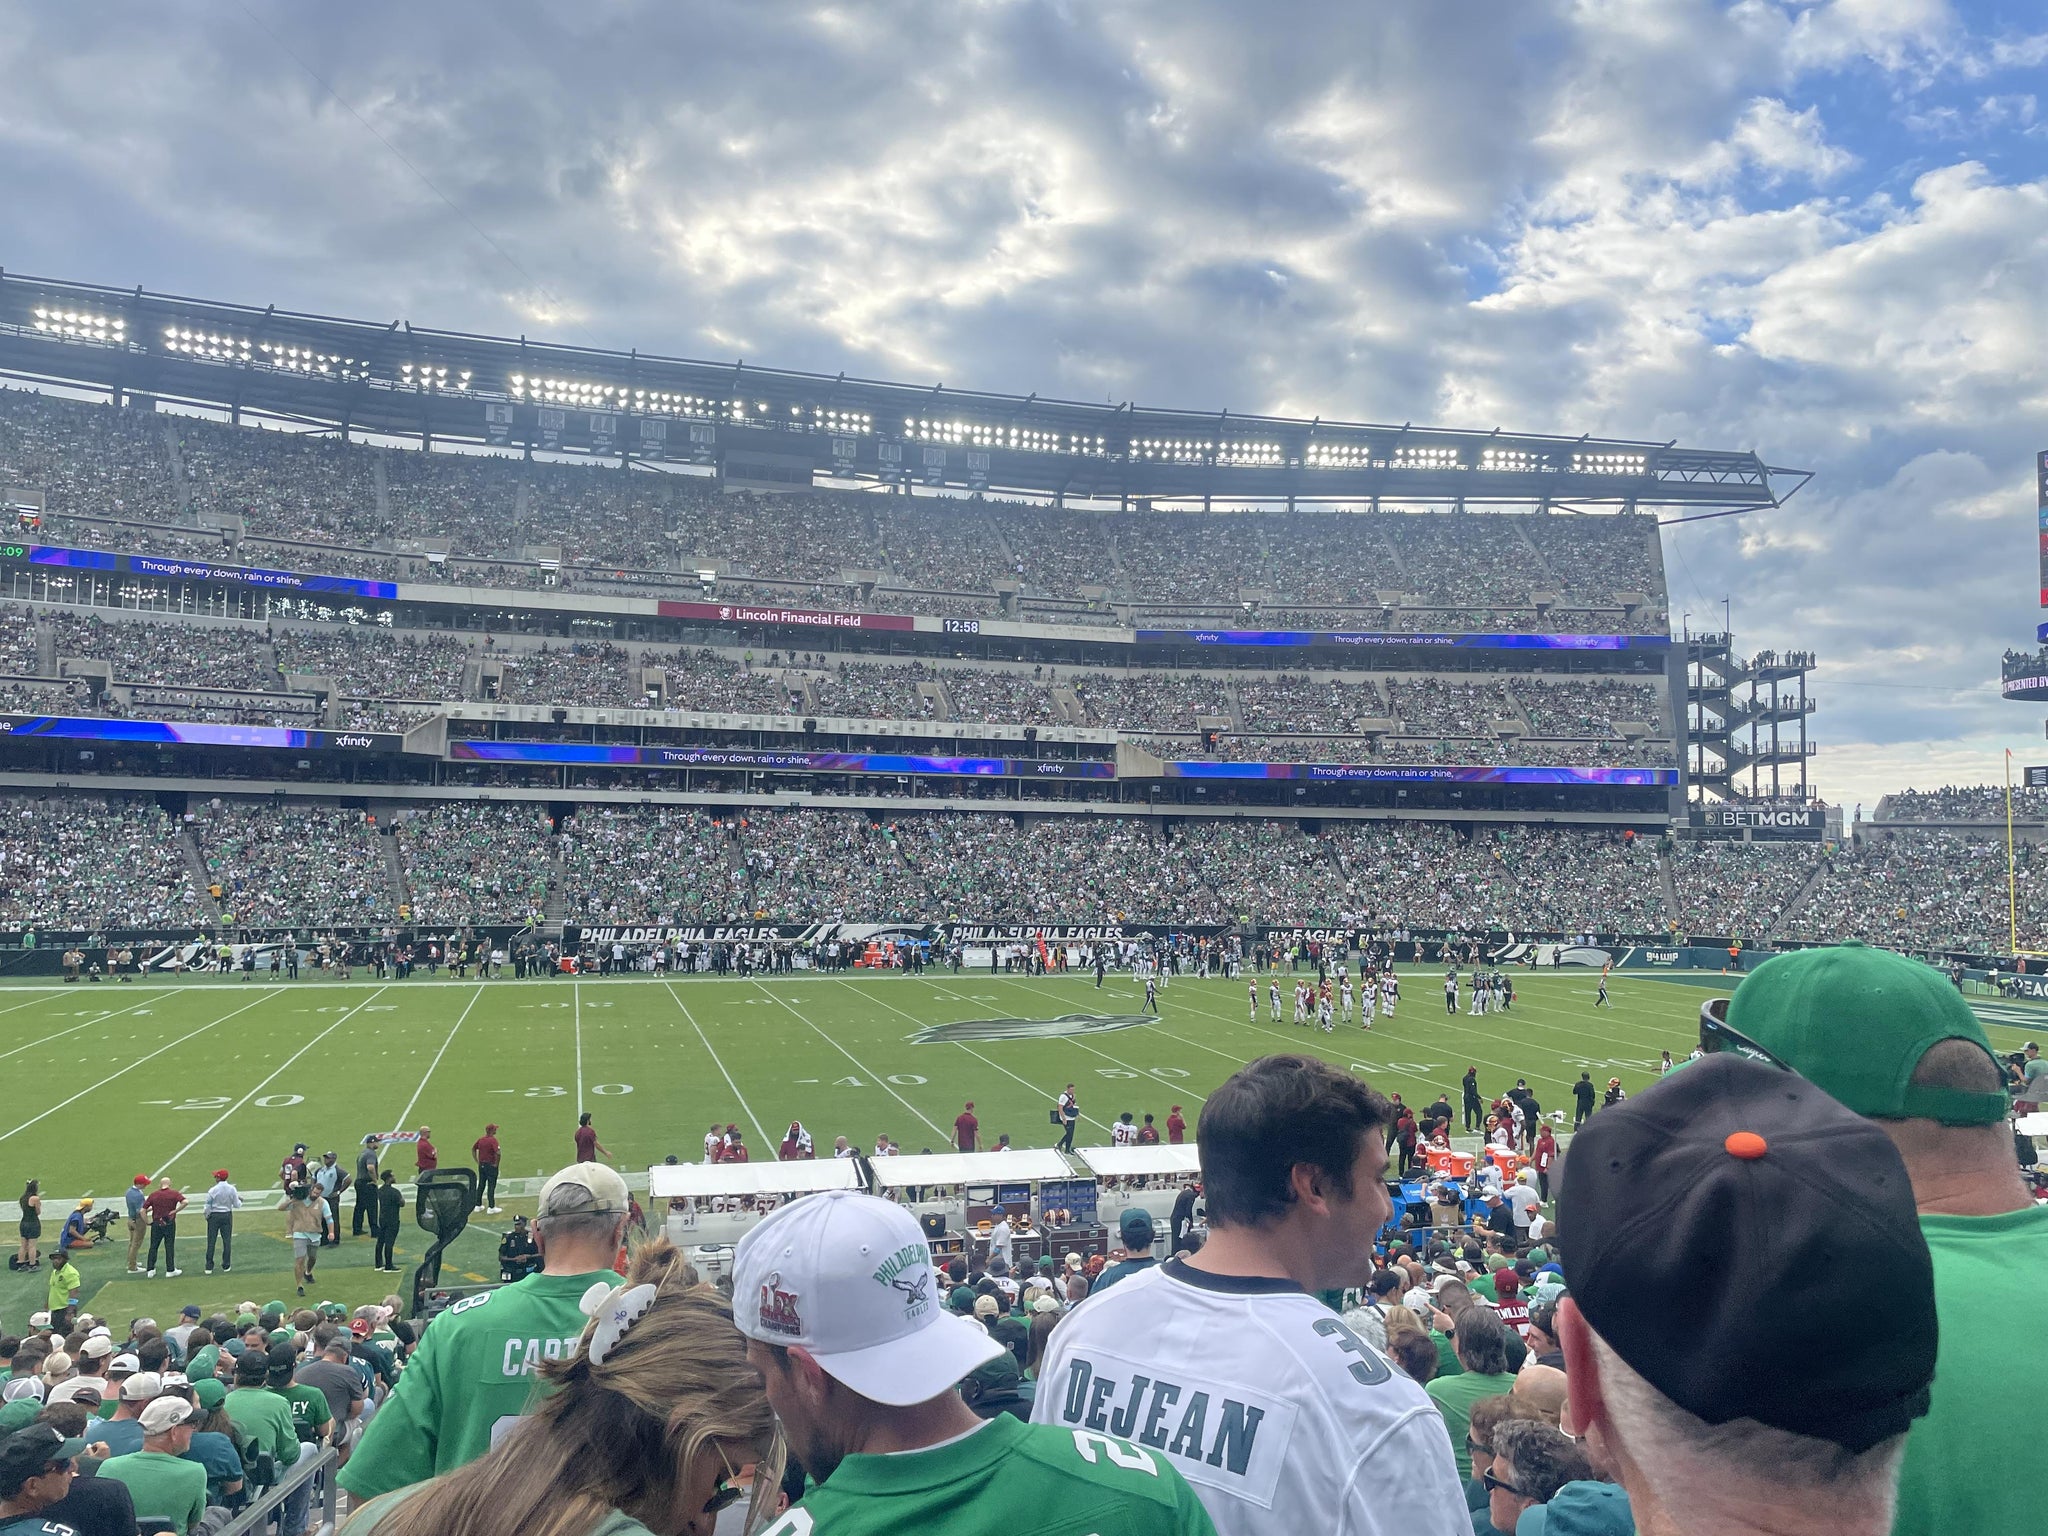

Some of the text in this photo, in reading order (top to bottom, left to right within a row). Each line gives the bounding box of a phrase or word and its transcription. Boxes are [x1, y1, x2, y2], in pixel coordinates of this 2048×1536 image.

[0, 546, 24, 557] :09
[141, 560, 182, 574] Through
[184, 566, 211, 578] every
[214, 568, 242, 580] down,
[244, 572, 262, 581] rain
[276, 576, 302, 586] shine,
[736, 608, 860, 627] Lincoln Financial Field
[945, 620, 979, 633] 12:58
[1195, 634, 1218, 642] xfinity
[1334, 636, 1364, 644] Through
[1386, 636, 1408, 644] down,
[336, 734, 372, 748] xfinity
[663, 752, 700, 762] Through
[702, 754, 727, 764] every
[729, 754, 756, 763] down,
[758, 755, 774, 763] rain
[1037, 763, 1064, 774] xfinity
[1312, 768, 1346, 777] Through
[1348, 769, 1371, 778] every
[1374, 768, 1400, 777] down,
[1430, 770, 1454, 778] shine,
[1723, 812, 1809, 826] BETMGM
[580, 928, 779, 942] PHILADELPHIA EAGLES
[1066, 928, 1123, 939] EAGLES
[1292, 929, 1347, 942] EAGLE
[1094, 1067, 1191, 1079] 50
[832, 1074, 928, 1088] 40
[524, 1084, 634, 1097] 30
[172, 1094, 304, 1110] 20
[1117, 1129, 1129, 1143] 31
[1440, 1157, 1448, 1167] G
[1464, 1161, 1472, 1170] G
[1506, 1160, 1515, 1168] G
